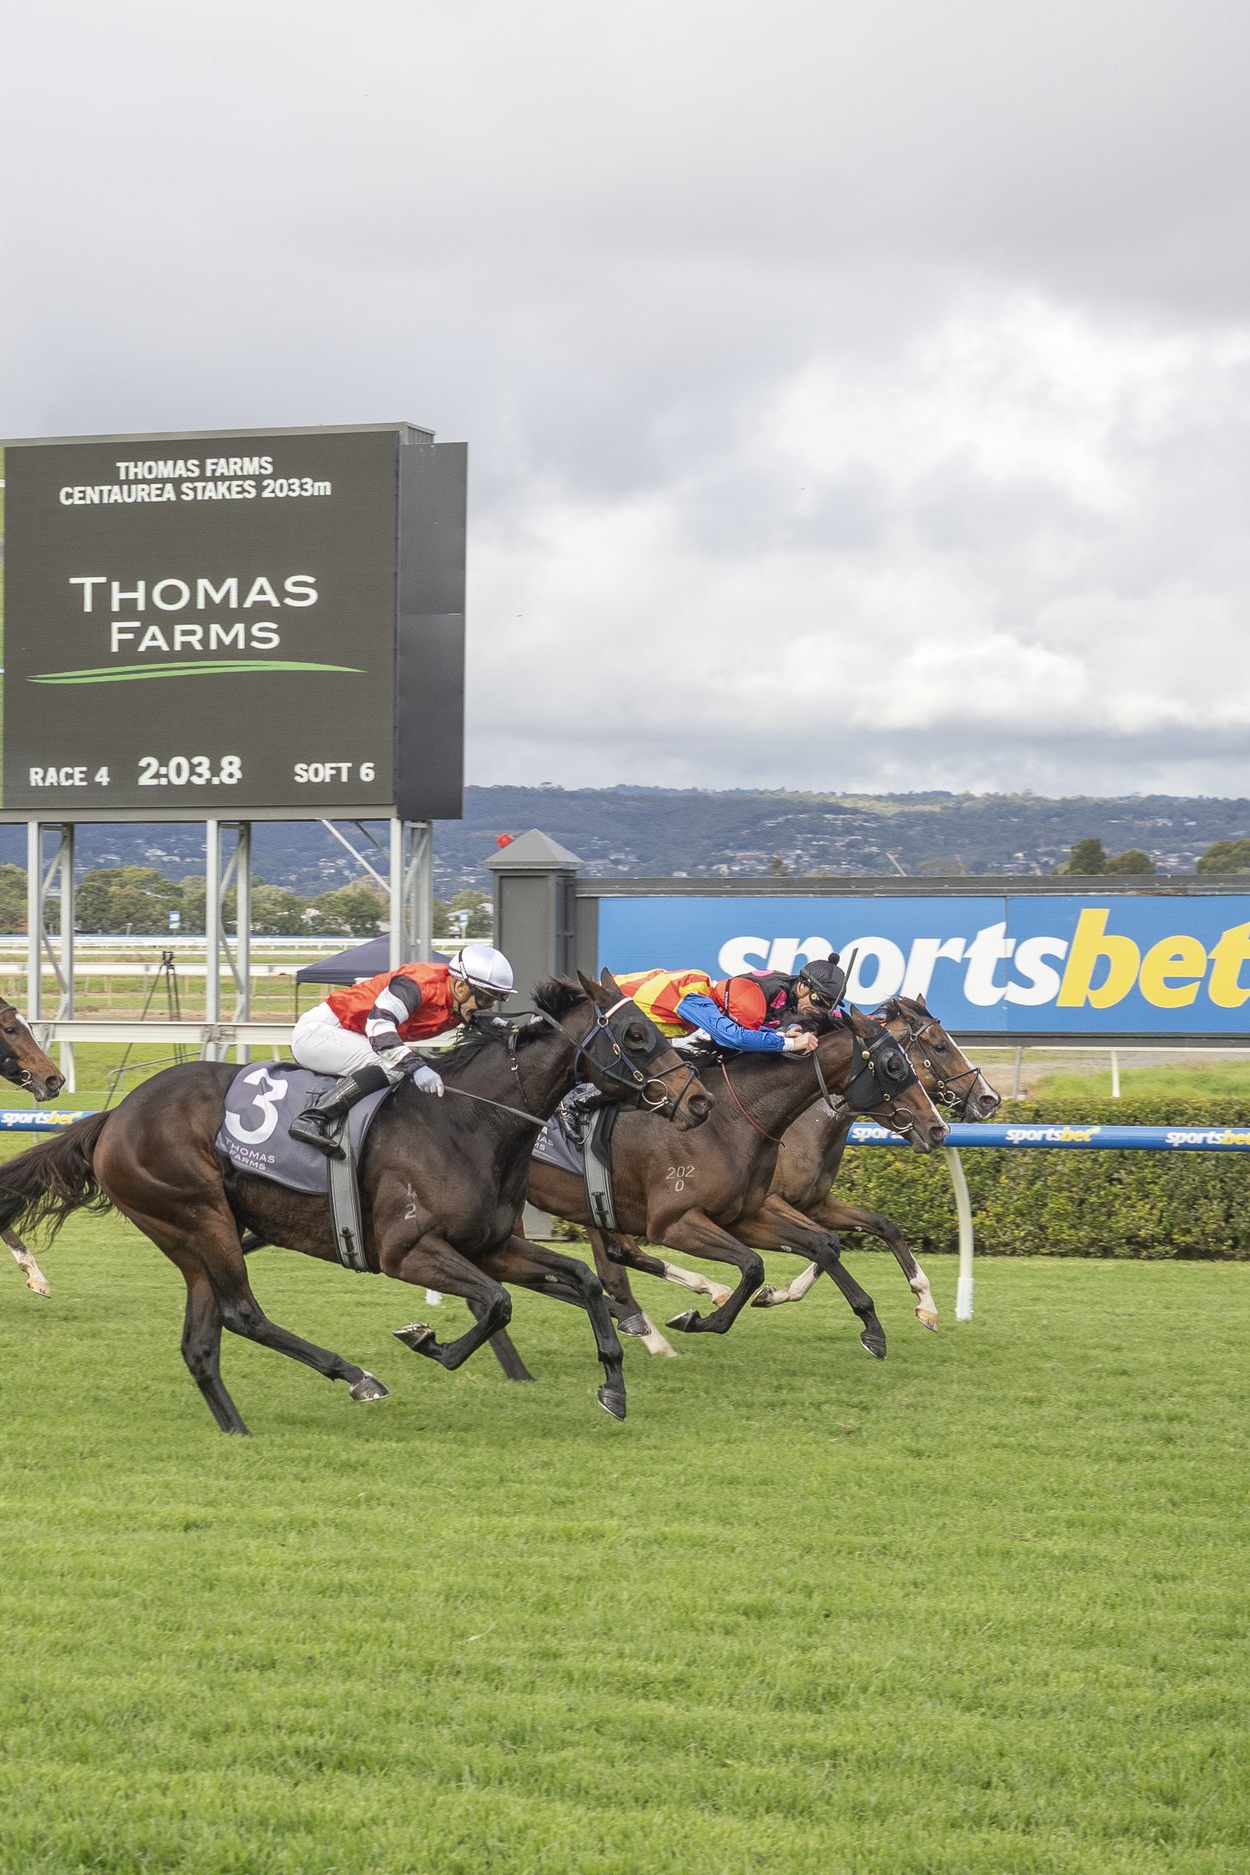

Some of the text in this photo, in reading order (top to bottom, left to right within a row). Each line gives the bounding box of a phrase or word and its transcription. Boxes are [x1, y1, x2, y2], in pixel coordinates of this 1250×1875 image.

[116, 456, 273, 480] THOMAS FARMS
[59, 478, 332, 506] CENTAUREA STAKES 2033m
[69, 574, 319, 613] THOMAS
[110, 621, 281, 653] FARMS
[29, 766, 110, 787] RACE 4
[137, 755, 243, 787] 2:03.8
[293, 762, 375, 784] SOFT 6
[225, 1067, 288, 1145] 3
[1, 1111, 81, 1126] sportsbet
[1005, 1126, 1100, 1144] sportsbet
[225, 1138, 276, 1164] THOMAS
[229, 1150, 266, 1171] FARMS
[666, 1165, 696, 1180] 202
[675, 1179, 684, 1192] 0
[404, 1203, 417, 1220] 2
